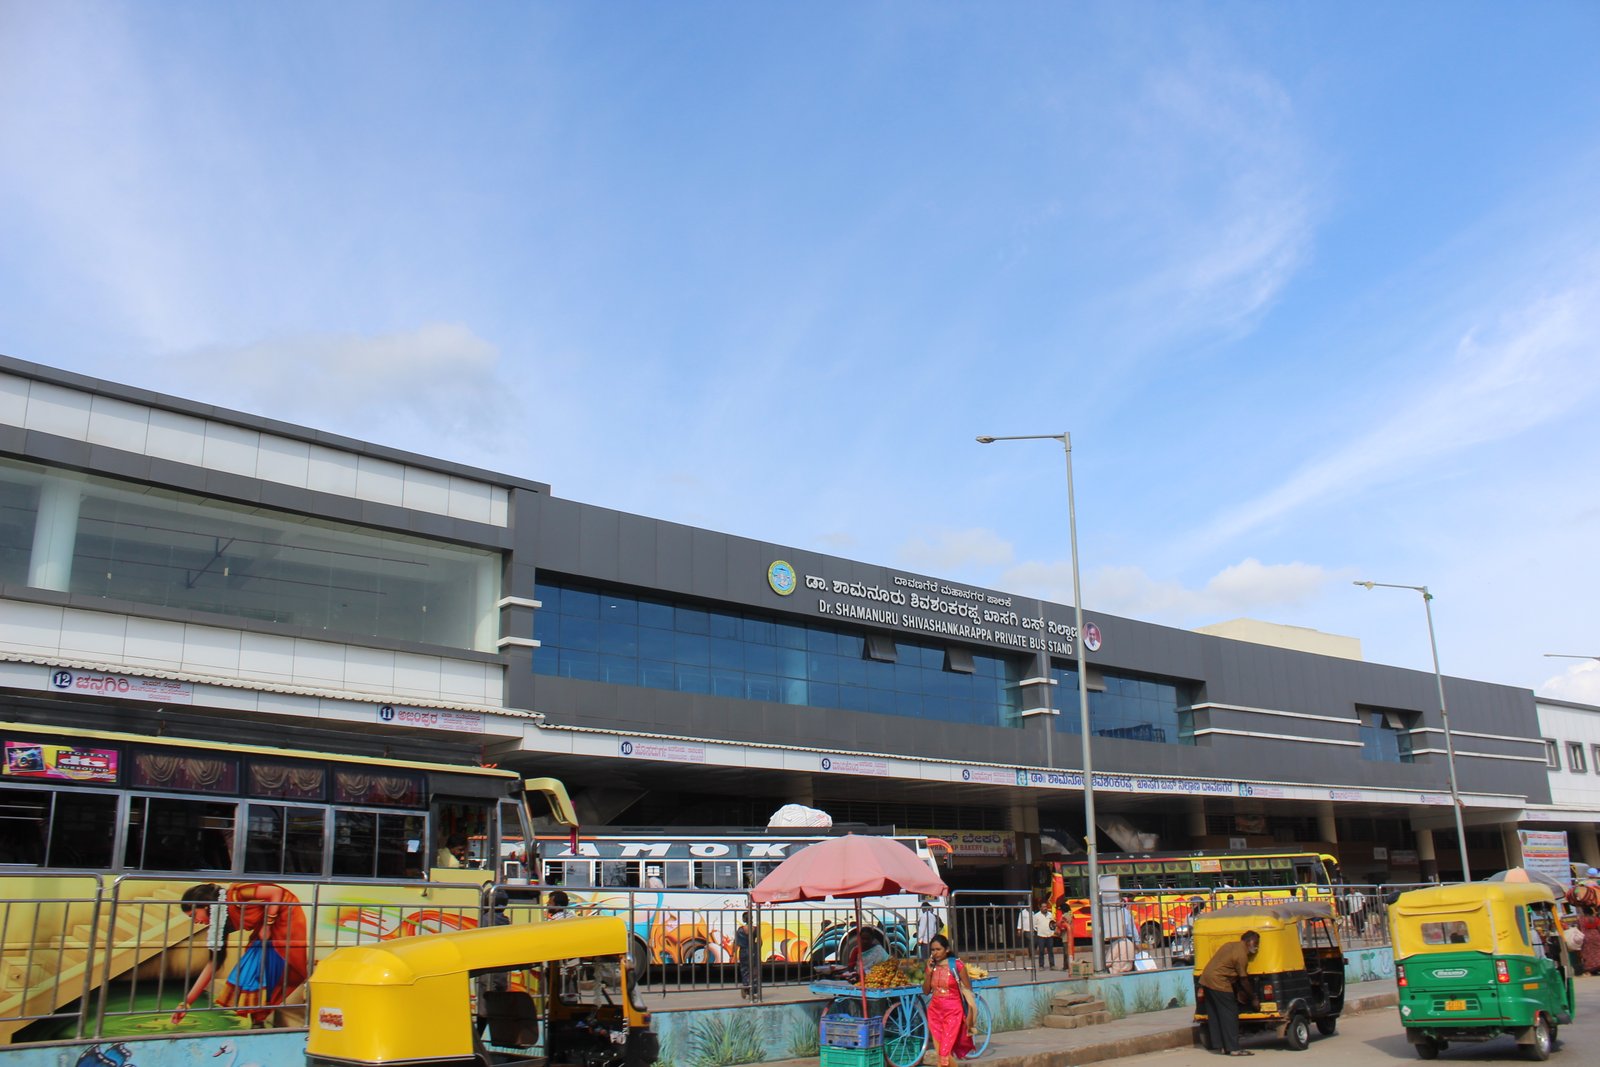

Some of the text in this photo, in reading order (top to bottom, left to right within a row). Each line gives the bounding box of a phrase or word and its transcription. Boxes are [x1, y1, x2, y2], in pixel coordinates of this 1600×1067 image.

[894, 575, 1012, 607] ದಾವಣಗೆರೆ ಮಹಾನಗರ ಪಾಲಿಕೆ
[805, 574, 829, 591] ಡಾ.
[832, 580, 906, 606] ಶಾಮನೂರು
[910, 592, 982, 625] ಶಿವಶಂಕರಪ್ಪ
[983, 609, 1019, 627] ಖಾಸಗಿ
[1021, 616, 1045, 631] ಬಸ್
[819, 599, 1073, 655] Dr. SHAMANURU SHIVASHANKARAPPA PRIVATE BUS STAND
[55, 672, 71, 687] 12
[75, 674, 130, 695] ಚನ್ನಗಿರಿ
[382, 707, 393, 720] 11
[58, 750, 111, 758] DIGITAL
[622, 743, 632, 754] 10
[58, 755, 107, 768] dts
